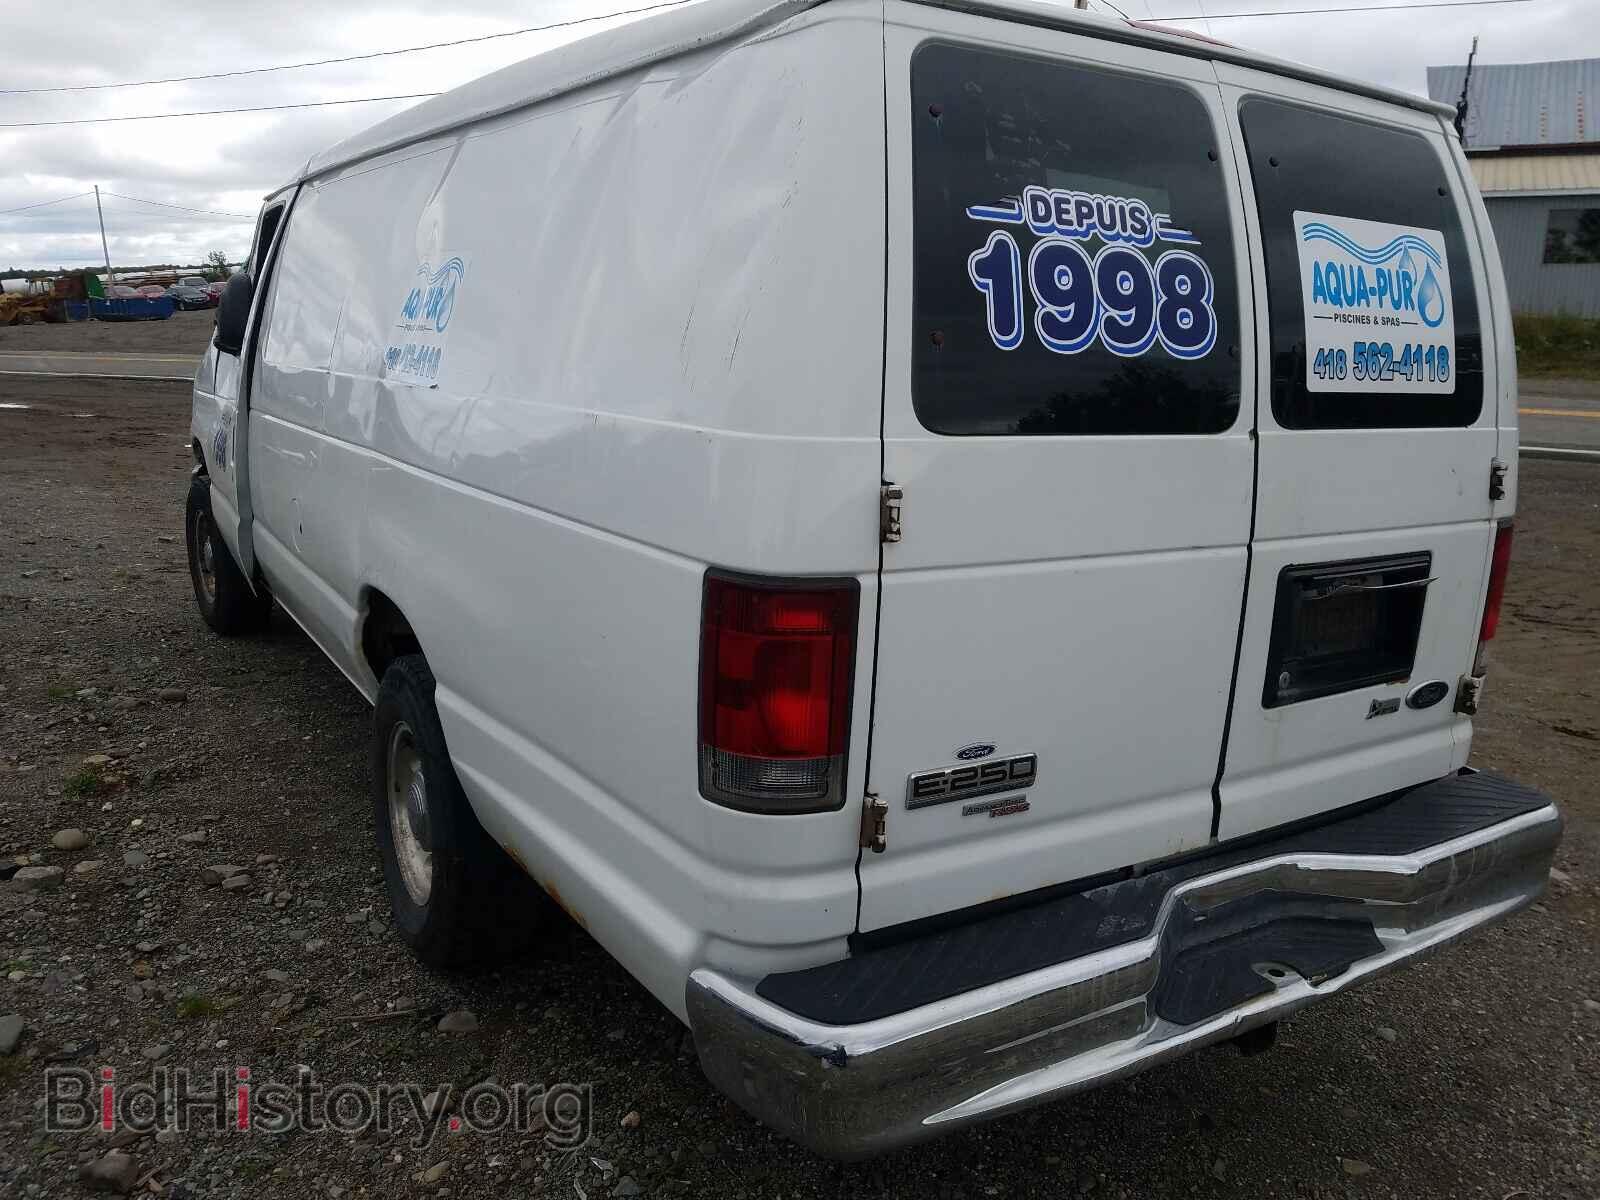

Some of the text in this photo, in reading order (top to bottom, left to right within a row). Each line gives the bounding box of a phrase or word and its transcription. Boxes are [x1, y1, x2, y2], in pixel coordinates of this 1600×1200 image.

[1024, 187, 1153, 246] DEPUIS
[968, 230, 1217, 360] 1998
[1313, 260, 1415, 311] AQUA-PUR
[1334, 313, 1400, 327] PISCINES & SPAS
[1313, 341, 1450, 383] 418 562-4118
[960, 746, 993, 759] Ford
[913, 757, 1036, 798] E-250
